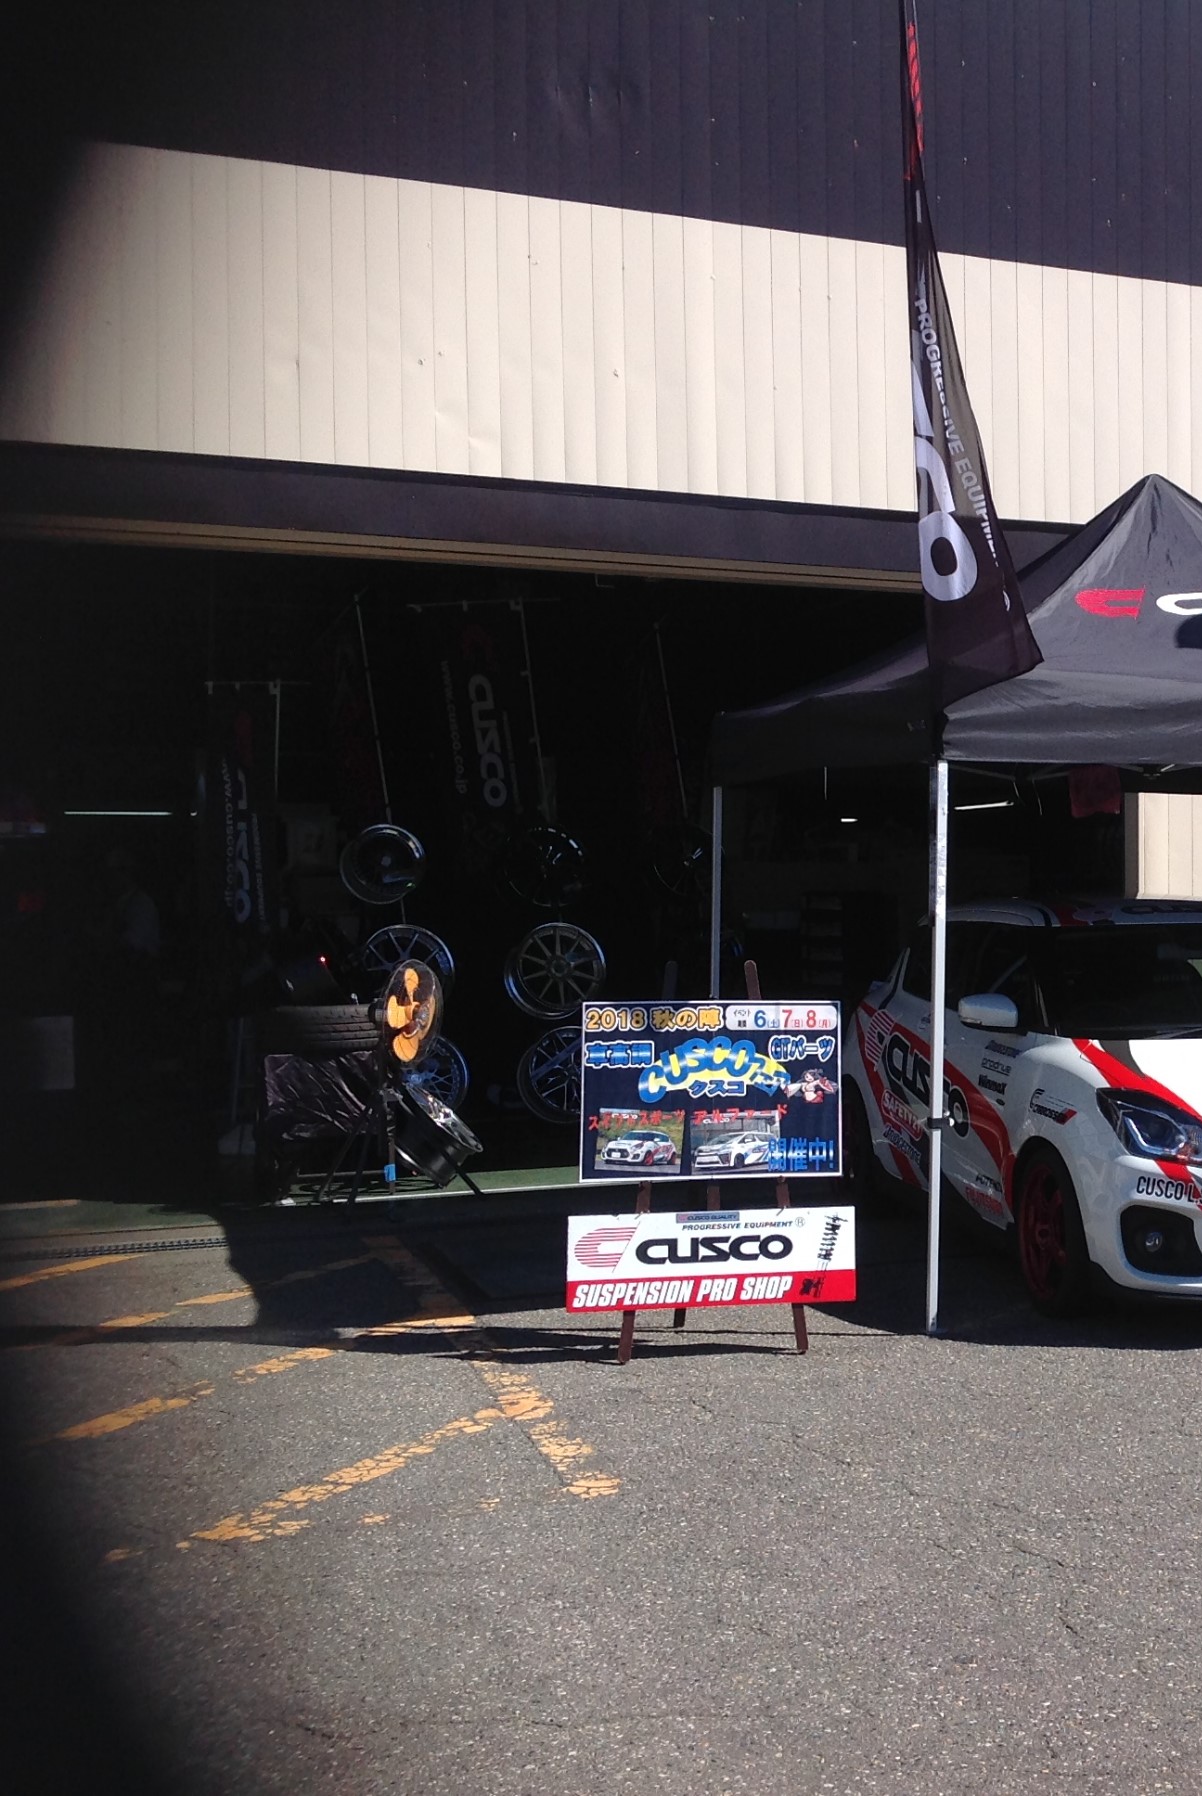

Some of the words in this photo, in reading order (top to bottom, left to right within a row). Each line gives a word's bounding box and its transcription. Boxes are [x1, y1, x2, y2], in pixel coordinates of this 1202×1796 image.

[468, 673, 508, 808] CUSCO
[585, 1009, 647, 1031] 2018
[651, 1007, 723, 1031] 秋の陣
[769, 1036, 834, 1061] GTパーツ
[689, 1080, 746, 1098] クスコ
[1136, 1175, 1184, 1201] CUSCO
[682, 1223, 741, 1231] PROGRESSIVE
[635, 1234, 793, 1265] CUSCO
[572, 1280, 694, 1308] SUSPENSION
[696, 1278, 738, 1302] PRO
[740, 1276, 793, 1300] SHOP
